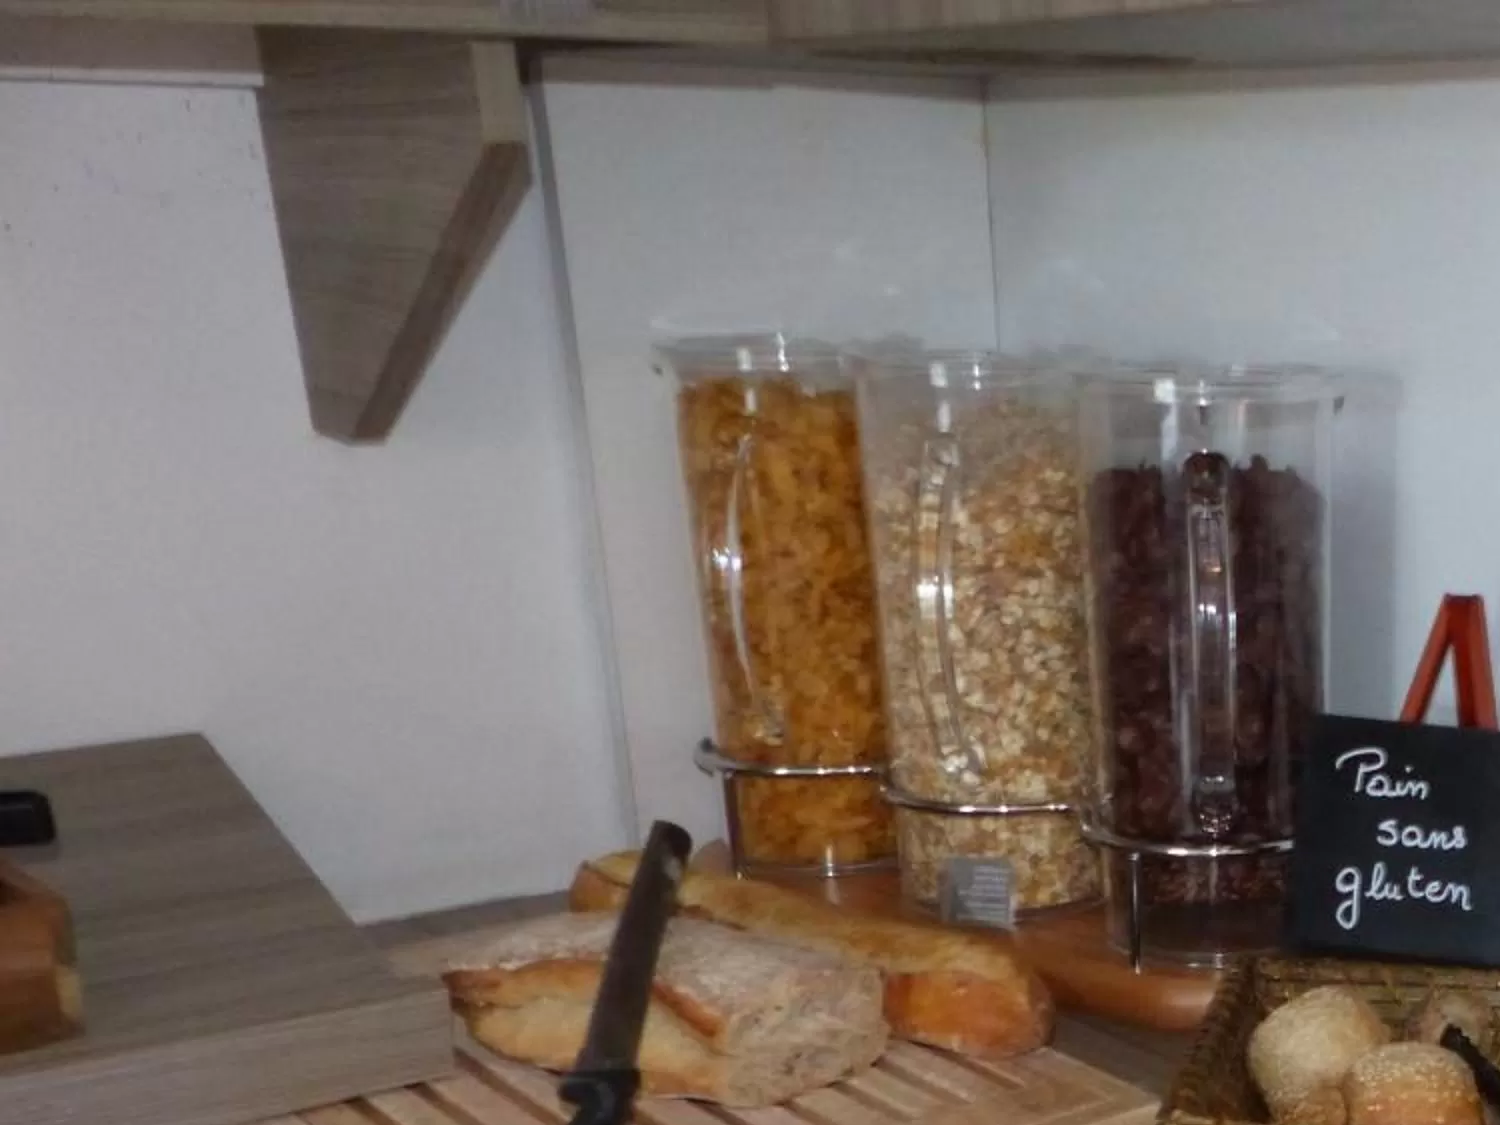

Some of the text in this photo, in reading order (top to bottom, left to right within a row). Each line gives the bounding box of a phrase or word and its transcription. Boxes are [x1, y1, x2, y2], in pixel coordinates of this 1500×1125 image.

[1335, 747, 1430, 799] Pain
[1376, 818, 1468, 850] sans
[1335, 861, 1473, 930] gluten
